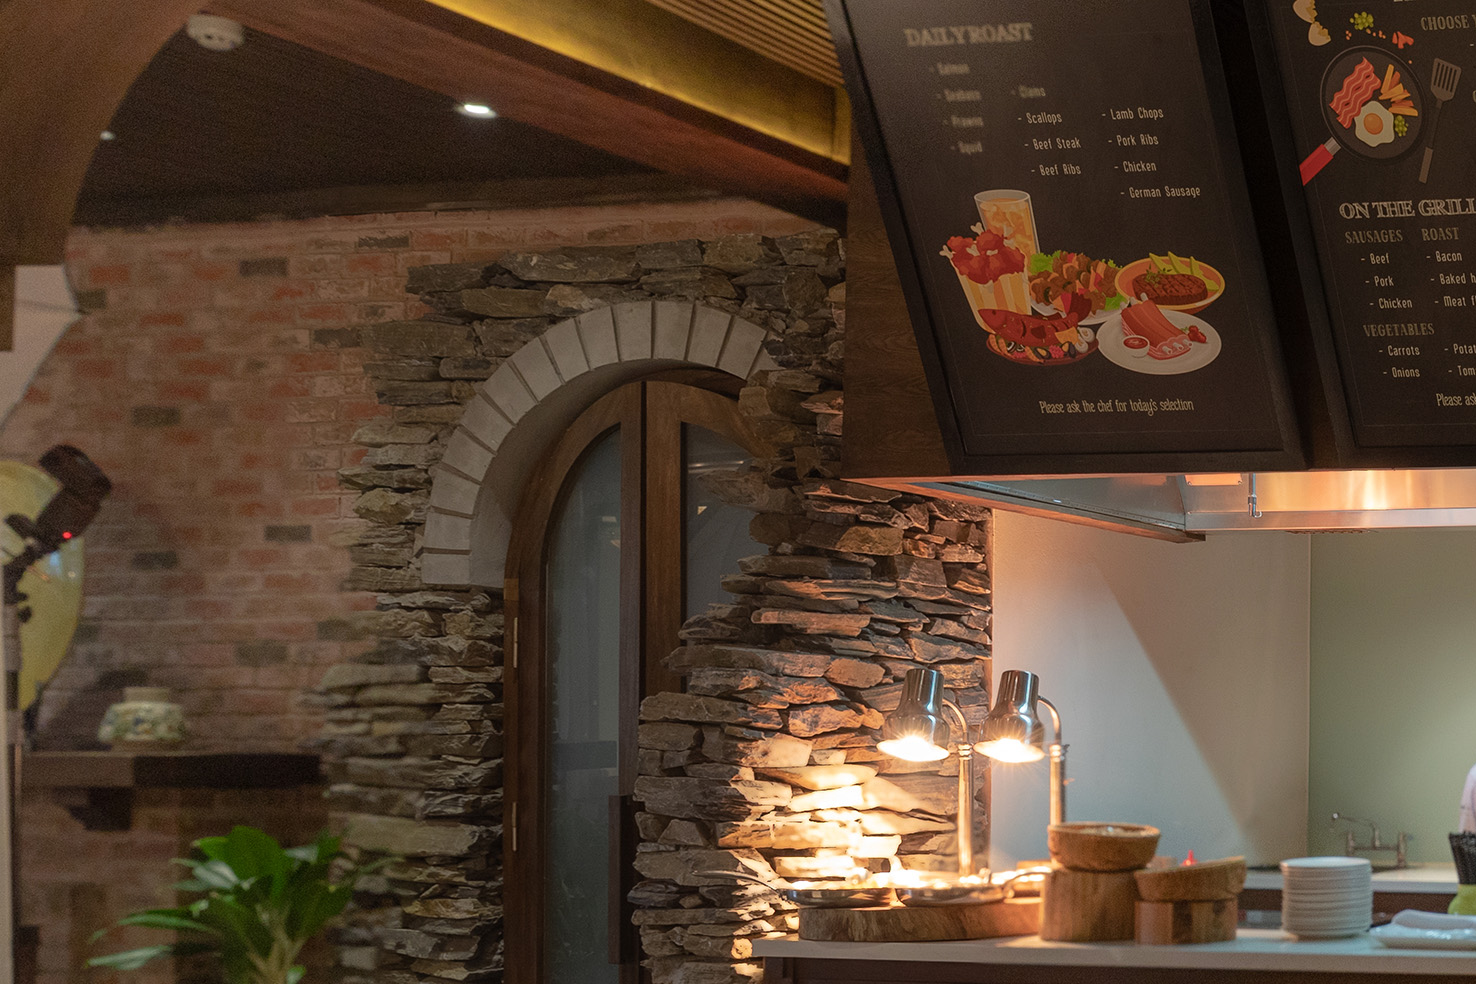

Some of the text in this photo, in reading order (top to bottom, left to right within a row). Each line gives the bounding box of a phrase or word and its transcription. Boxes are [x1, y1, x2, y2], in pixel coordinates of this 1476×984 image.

[1421, 15, 1470, 31] CHOOSE
[1026, 112, 1062, 125] Scallops
[1110, 107, 1164, 120] Lamb Chops
[1033, 137, 1081, 150] Beef Steak
[1116, 134, 1159, 146] Pork Ribs
[1039, 164, 1081, 176] Beef Ribs
[1123, 161, 1157, 172] Chicken
[1129, 186, 1200, 198] German Sausage
[1339, 202, 1370, 219] ON
[1371, 200, 1415, 218] THE
[1345, 229, 1403, 244] SAUSAGES
[1421, 227, 1459, 241] ROAST
[1370, 253, 1389, 264] Beef
[1435, 251, 1462, 262] Bacon
[1374, 276, 1394, 287] Pork
[1439, 273, 1466, 285] Baked
[1379, 298, 1413, 309] Chicken
[1443, 296, 1466, 307] Meat
[1363, 323, 1435, 337] VEGETABLES
[1388, 345, 1420, 356] Carrots
[1392, 367, 1420, 378] Onions
[1039, 401, 1065, 413] Please
[1066, 400, 1081, 413] ask
[1082, 400, 1096, 412] the
[1097, 399, 1113, 412] chef
[1115, 399, 1127, 412] for
[1159, 398, 1194, 411] selection
[1436, 393, 1463, 406] Please
